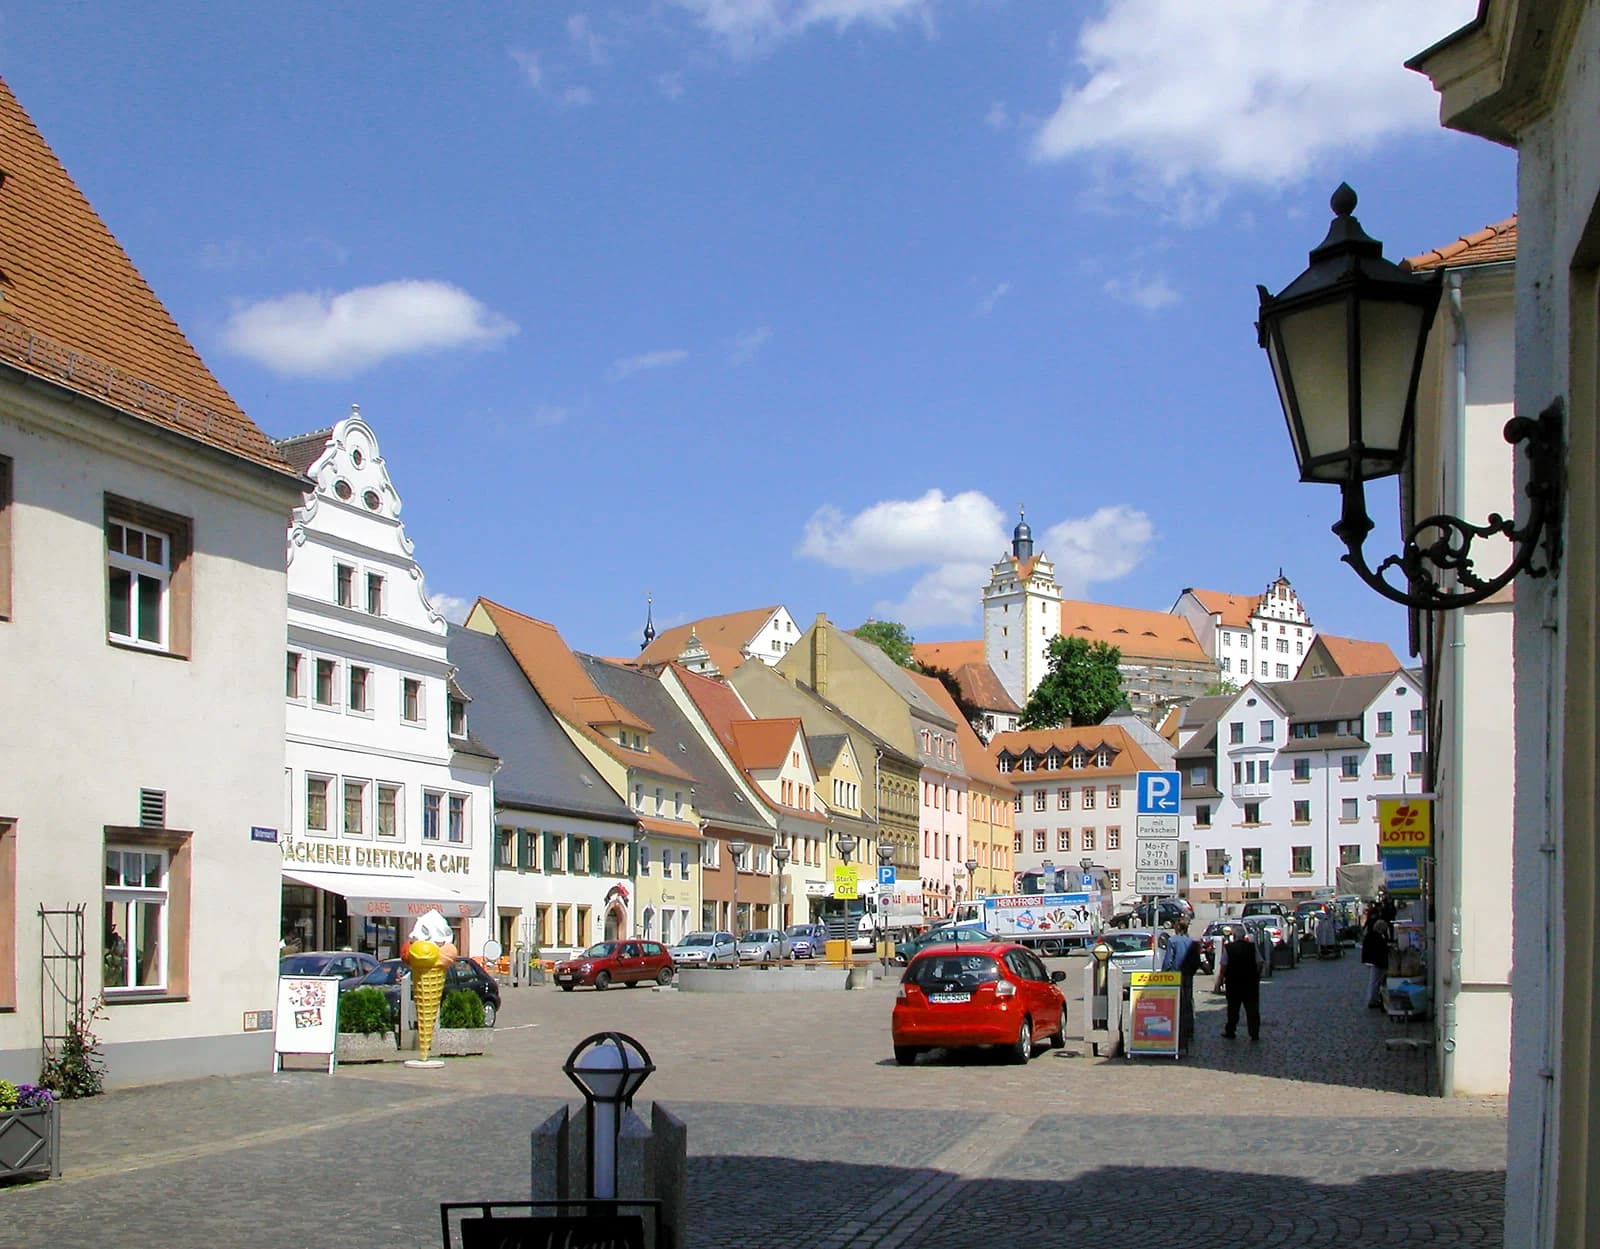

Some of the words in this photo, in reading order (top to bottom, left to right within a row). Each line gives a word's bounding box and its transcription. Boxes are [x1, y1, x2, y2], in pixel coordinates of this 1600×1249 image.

[1147, 776, 1170, 809] P
[1139, 826, 1177, 834] Parkschein
[1382, 830, 1425, 841] LOTTO
[280, 836, 351, 865] ÄCKEREI
[355, 846, 422, 871] DIETRICH
[426, 853, 436, 873] &
[439, 855, 470, 874] CAFE
[881, 869, 892, 883] P
[1083, 875, 1090, 884] P
